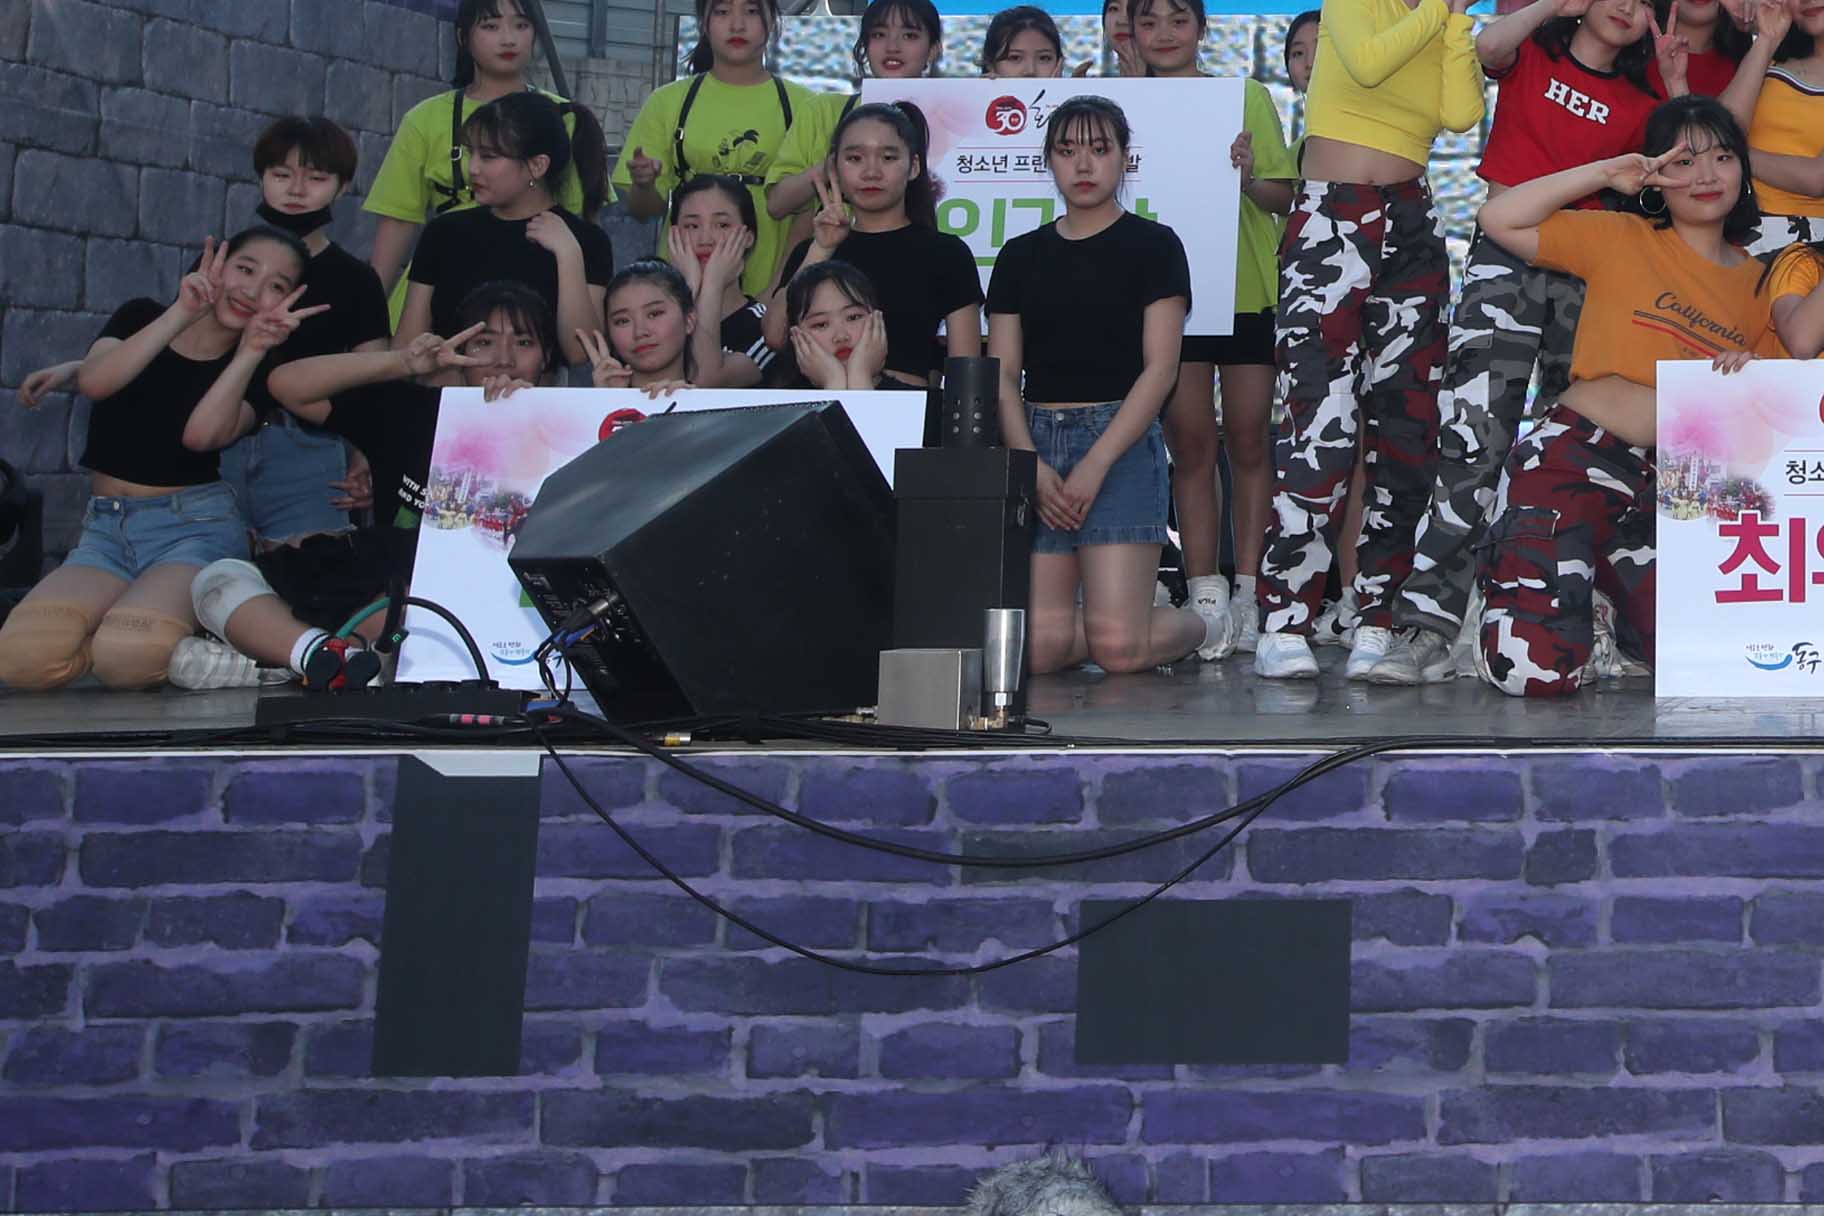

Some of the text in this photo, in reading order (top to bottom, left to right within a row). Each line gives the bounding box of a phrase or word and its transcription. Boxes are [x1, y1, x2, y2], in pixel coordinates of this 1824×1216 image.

[1544, 78, 1610, 124] HER
[957, 154, 1009, 174] 청소년
[1656, 292, 1746, 346] California
[1792, 641, 1822, 674] 동구
